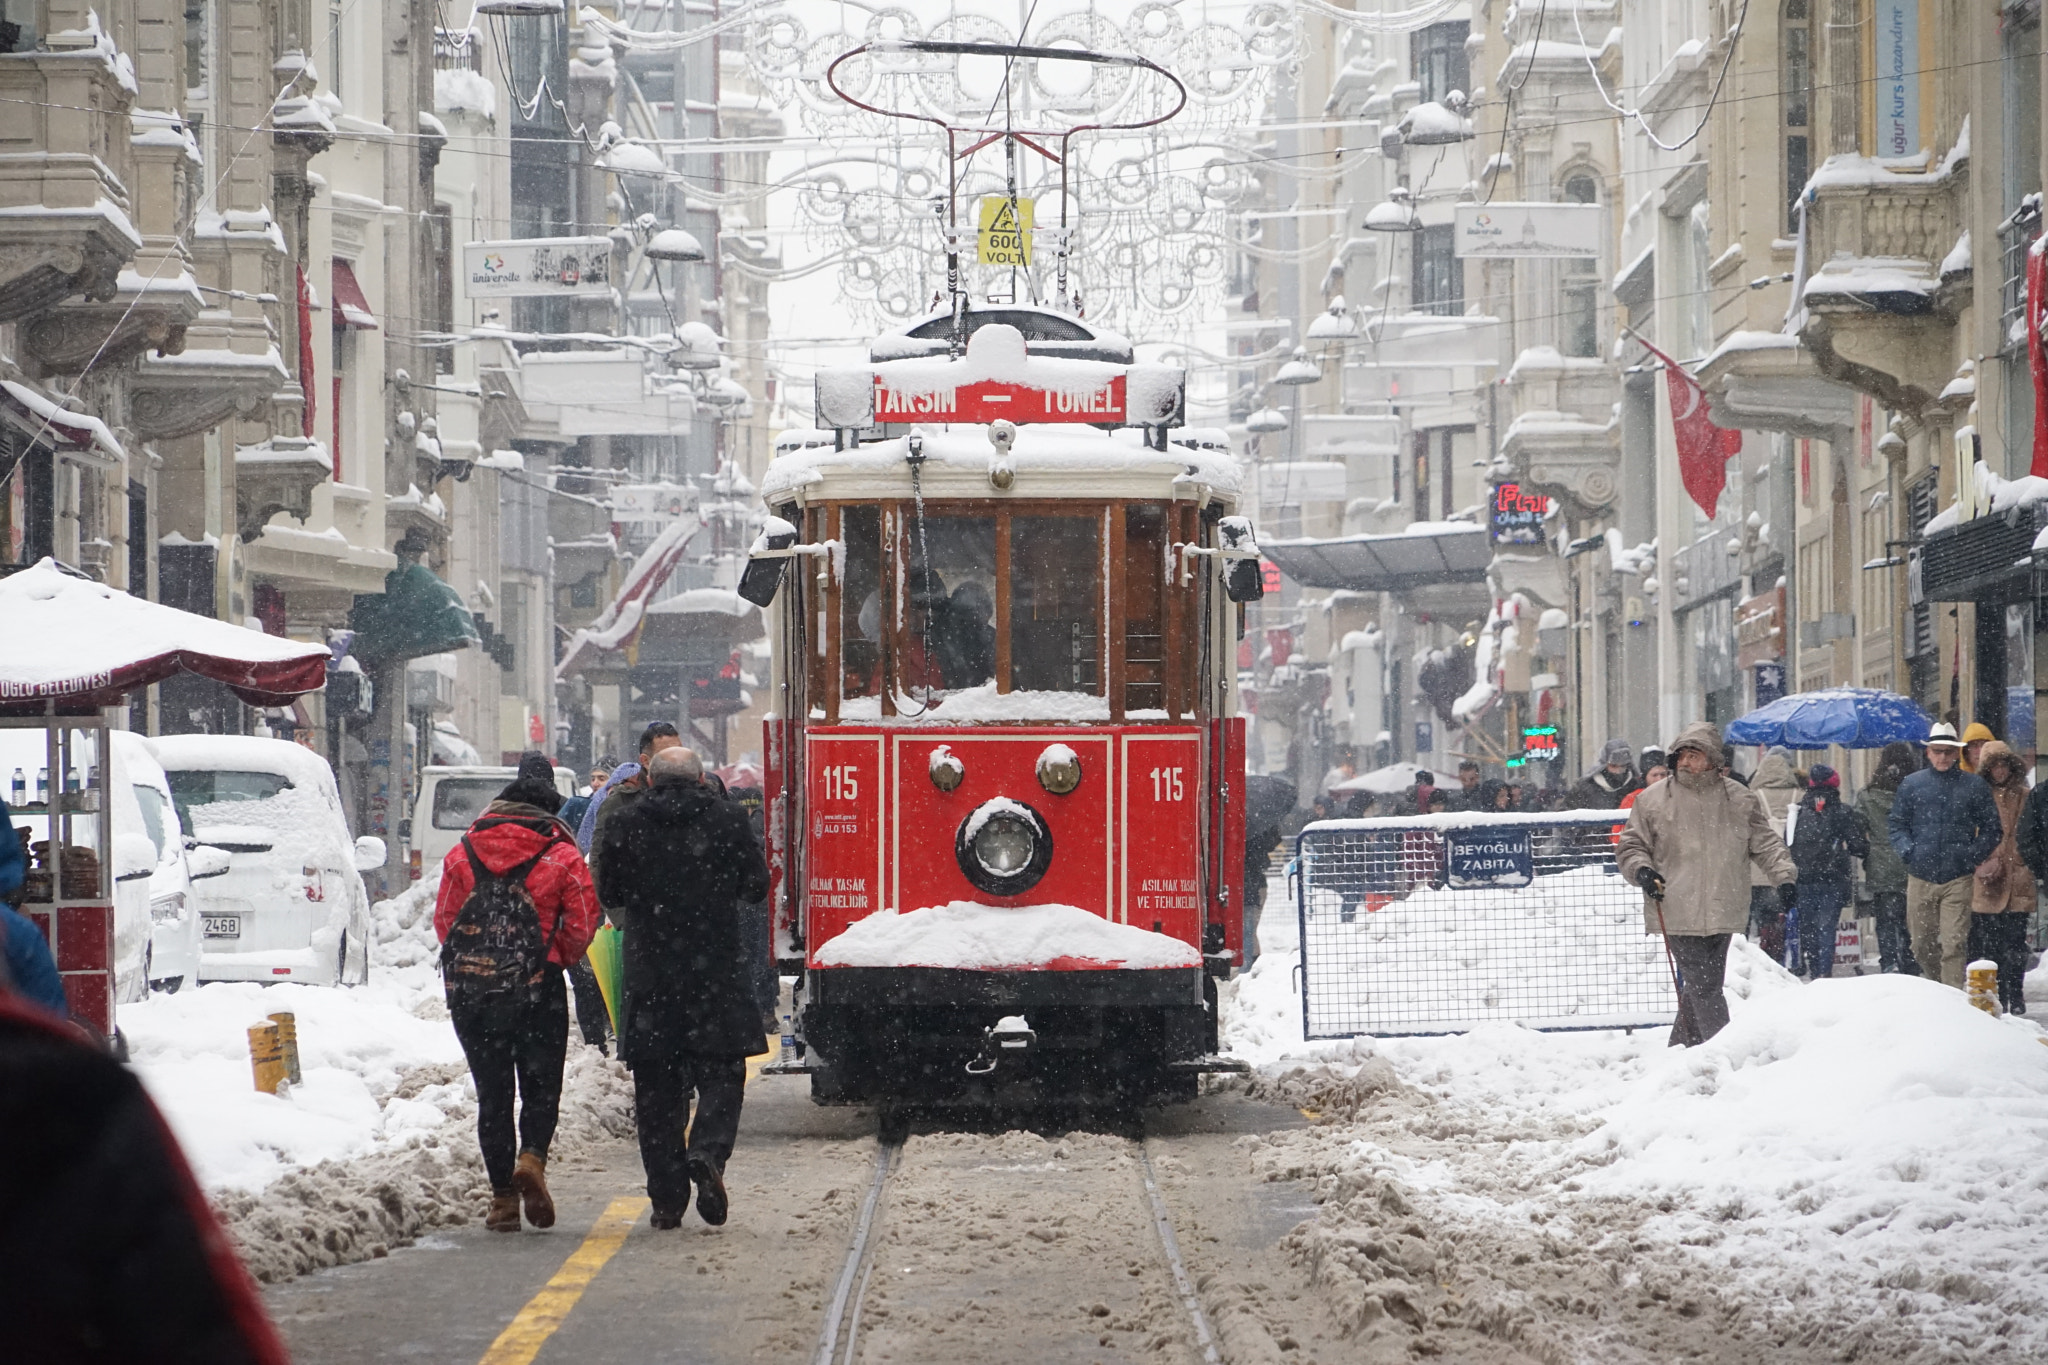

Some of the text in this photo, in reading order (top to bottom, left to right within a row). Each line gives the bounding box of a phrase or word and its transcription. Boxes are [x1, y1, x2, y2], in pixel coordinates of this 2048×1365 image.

[1890, 84, 1905, 119] kurs
[1890, 119, 1908, 155] uğur
[989, 234, 1021, 250] 600
[986, 252, 1022, 265] VOLT
[822, 765, 858, 800] 115
[1150, 767, 1184, 802] 115
[824, 824, 858, 834] ALO 153
[1455, 840, 1523, 857] BEYOĞLU
[1462, 858, 1516, 871] ZABITA
[836, 878, 866, 892] YASAK
[1142, 879, 1178, 892] ASILMAK
[1137, 895, 1150, 909] VE
[205, 918, 237, 933] 2468
